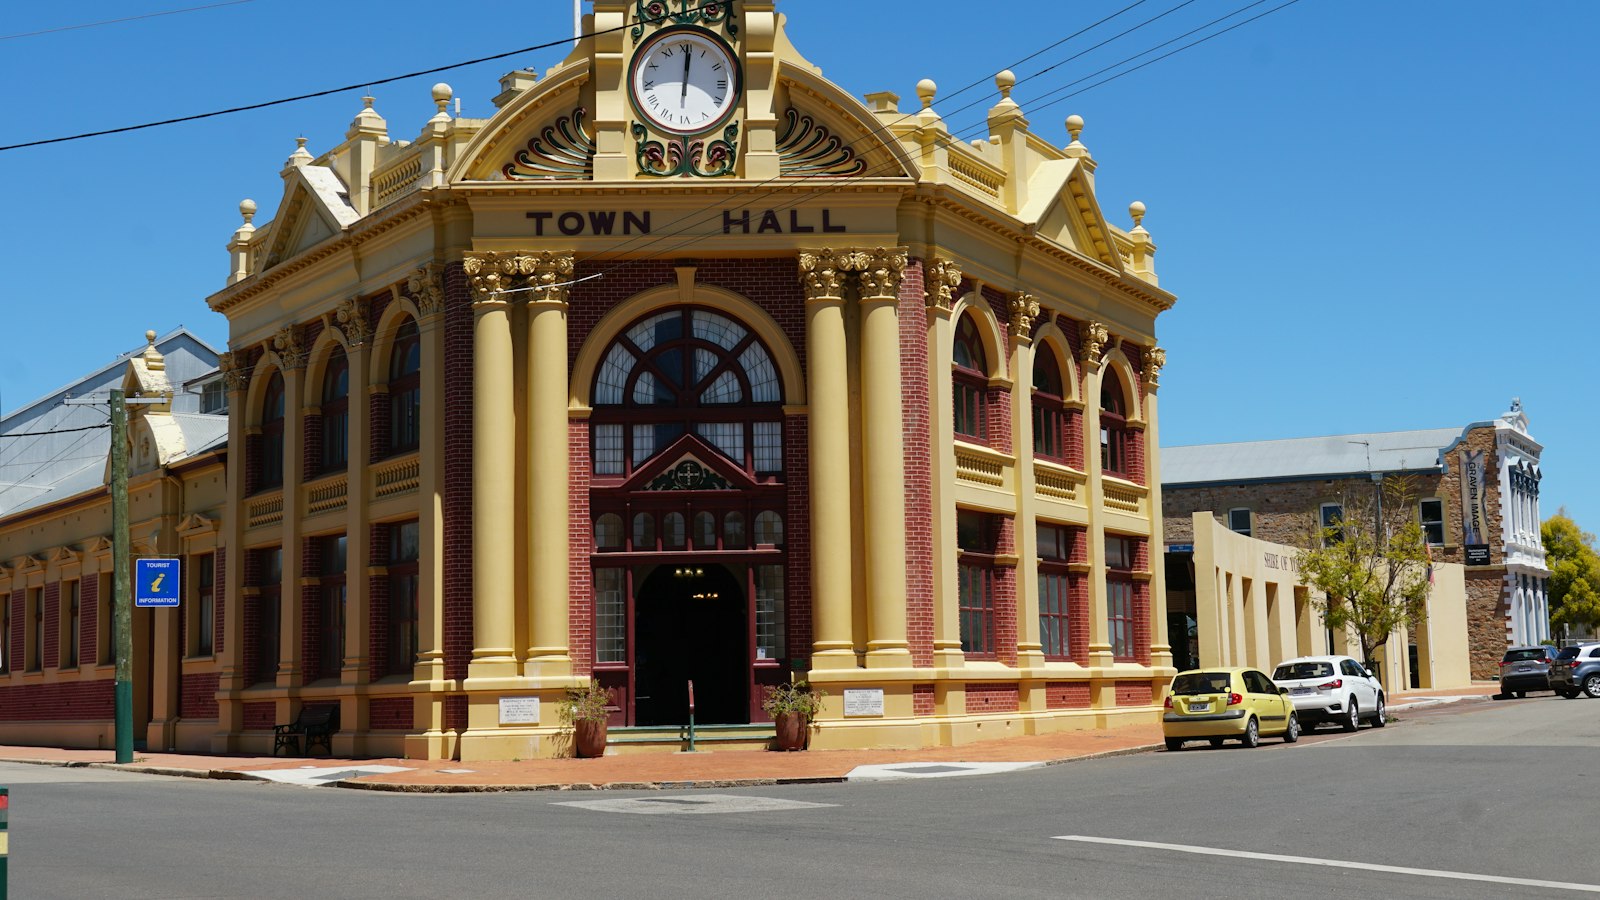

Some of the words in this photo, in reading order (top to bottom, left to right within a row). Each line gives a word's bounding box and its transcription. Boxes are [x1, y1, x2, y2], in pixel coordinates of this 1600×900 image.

[679, 43, 693, 54] XI
[648, 61, 659, 71] X
[717, 80, 726, 89] III
[526, 211, 650, 236] TOWN
[723, 209, 846, 234] HALL
[1469, 462, 1478, 500] GRAVEN
[1264, 552, 1279, 569] SHIRE
[1281, 555, 1288, 571] OF
